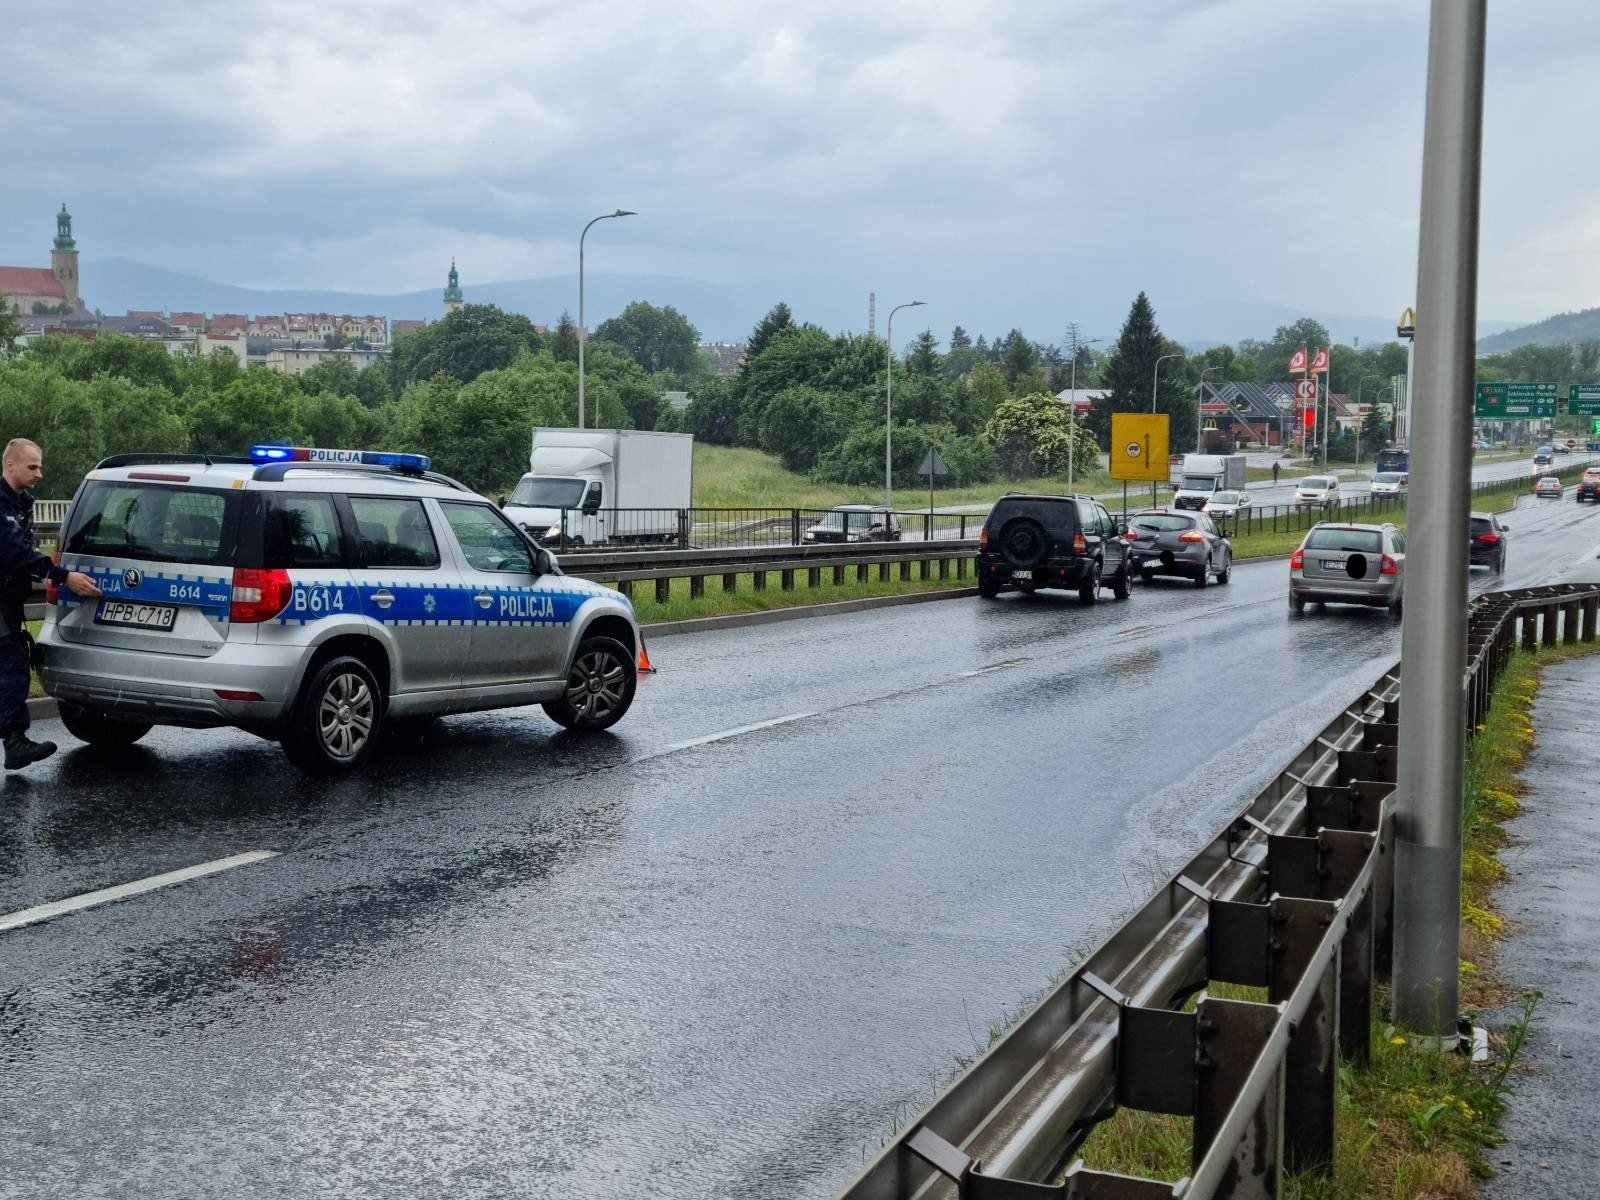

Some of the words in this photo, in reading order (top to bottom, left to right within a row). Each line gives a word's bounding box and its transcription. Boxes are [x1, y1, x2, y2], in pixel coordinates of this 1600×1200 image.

[1302, 384, 1313, 396] K
[310, 450, 360, 462] POLICJA
[169, 584, 201, 599] B614
[294, 588, 344, 612] B614
[499, 595, 555, 618] POLICJA
